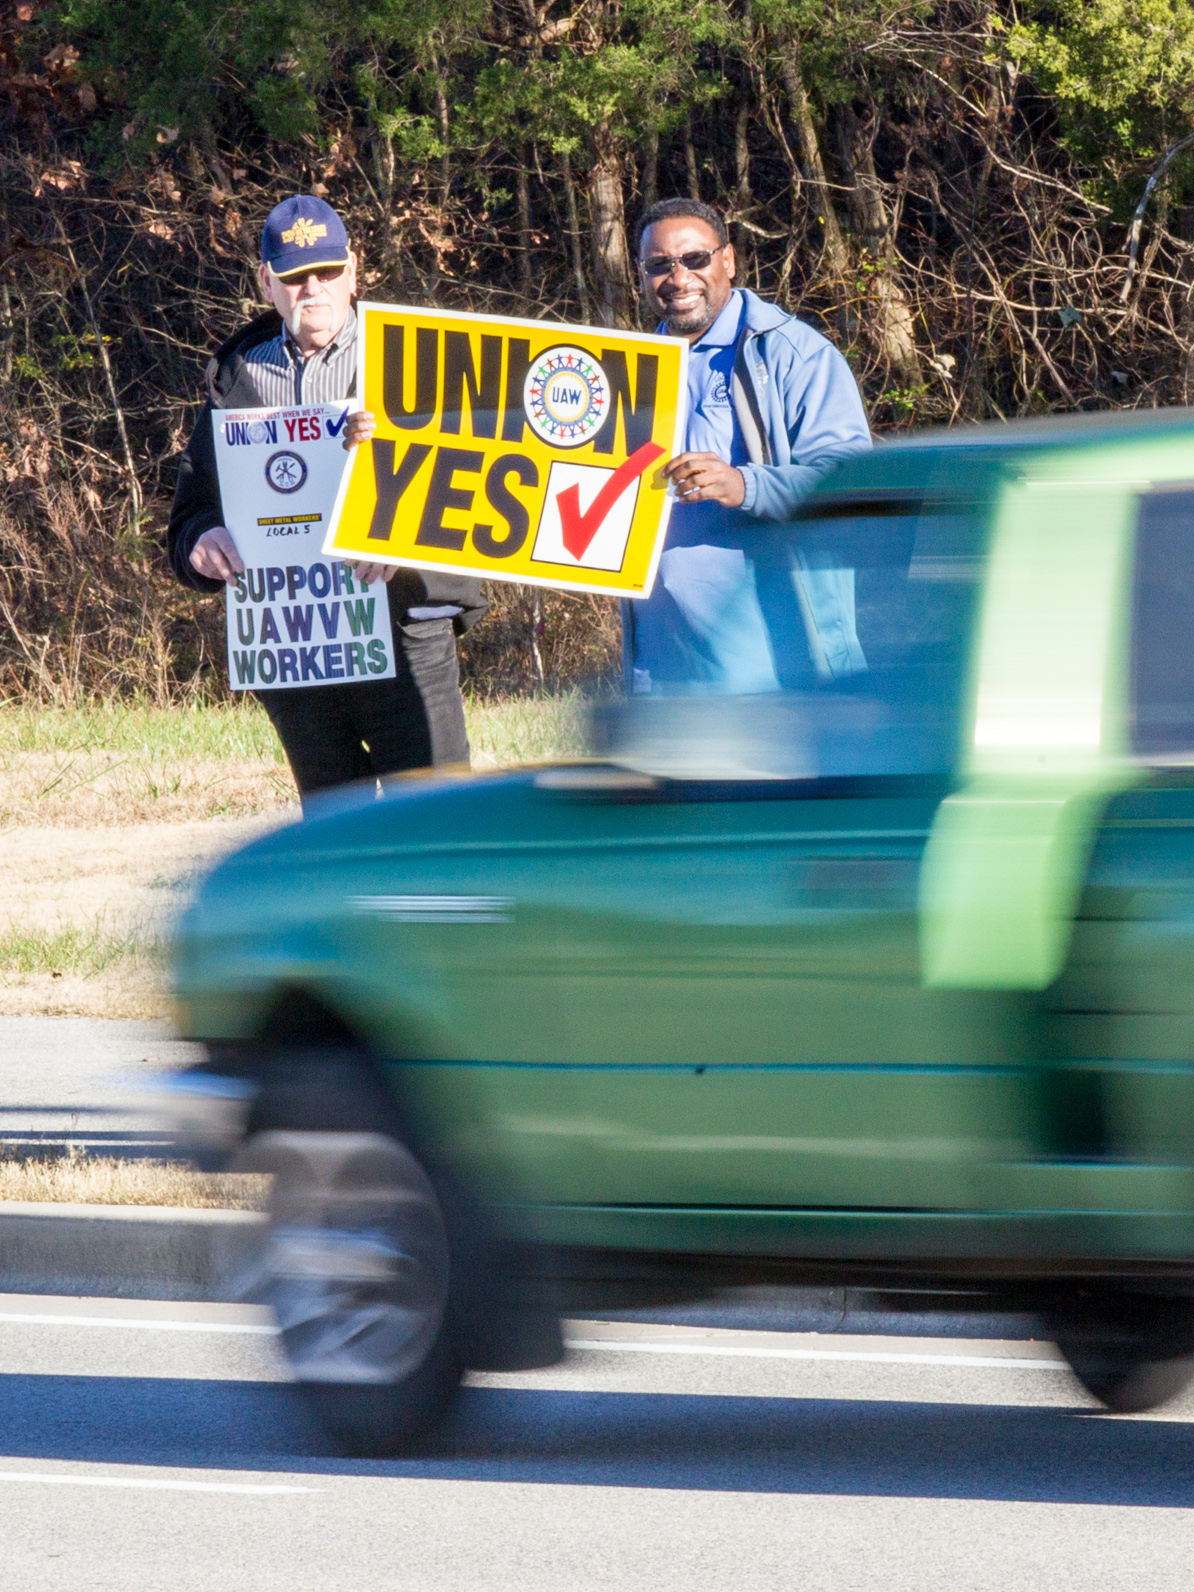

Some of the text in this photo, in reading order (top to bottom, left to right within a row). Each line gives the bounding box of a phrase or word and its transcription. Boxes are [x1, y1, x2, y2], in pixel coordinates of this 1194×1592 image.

[382, 324, 659, 458] UNION
[552, 386, 582, 405] UAW
[266, 411, 280, 419] BEST
[282, 410, 301, 418] WHEN
[302, 408, 311, 416] WE
[284, 416, 321, 442] YES
[367, 437, 540, 559] YES
[266, 526, 299, 537] LOCAL
[233, 639, 388, 685] WORKERS
